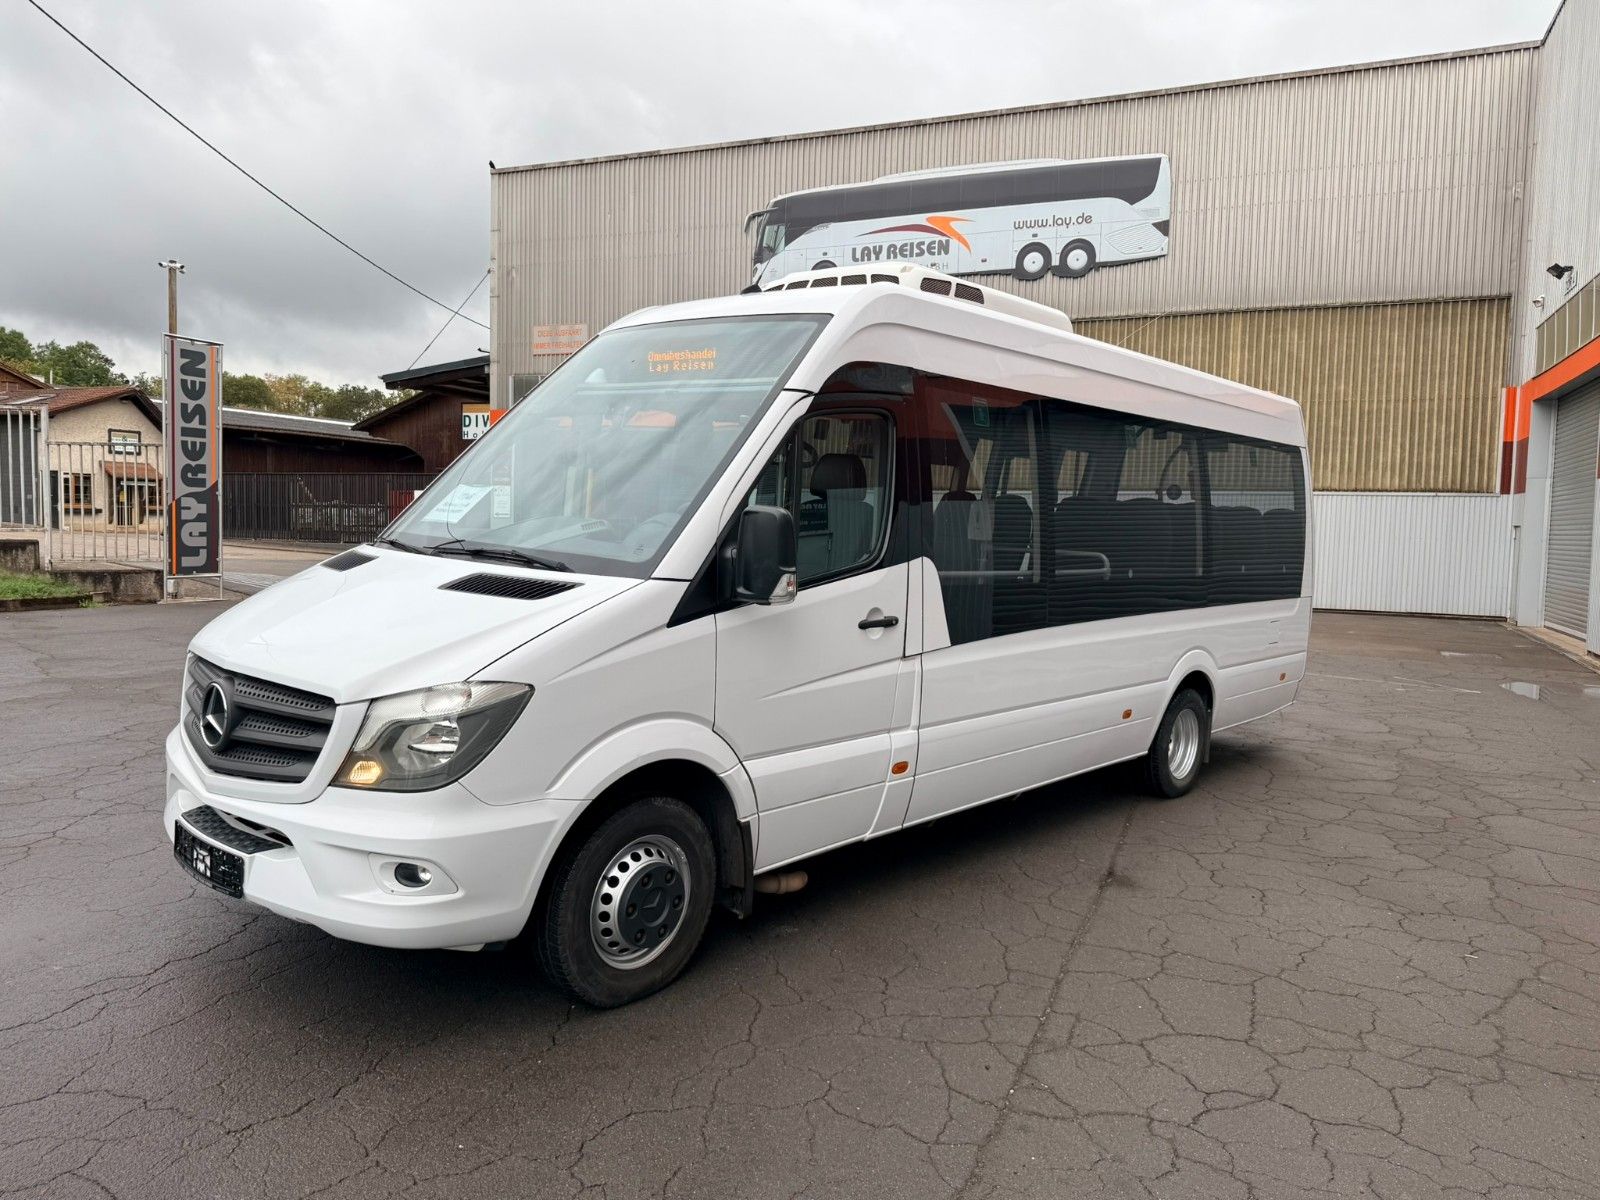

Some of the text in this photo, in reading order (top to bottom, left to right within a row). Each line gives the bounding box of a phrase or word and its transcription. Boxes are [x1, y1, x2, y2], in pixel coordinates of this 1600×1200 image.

[1013, 212, 1093, 230] www.lay.de
[851, 239, 950, 263] LAY REISEN
[649, 360, 714, 373] Lay Reisen
[463, 430, 485, 438] Ho
[179, 348, 208, 568] LAY REISEN
